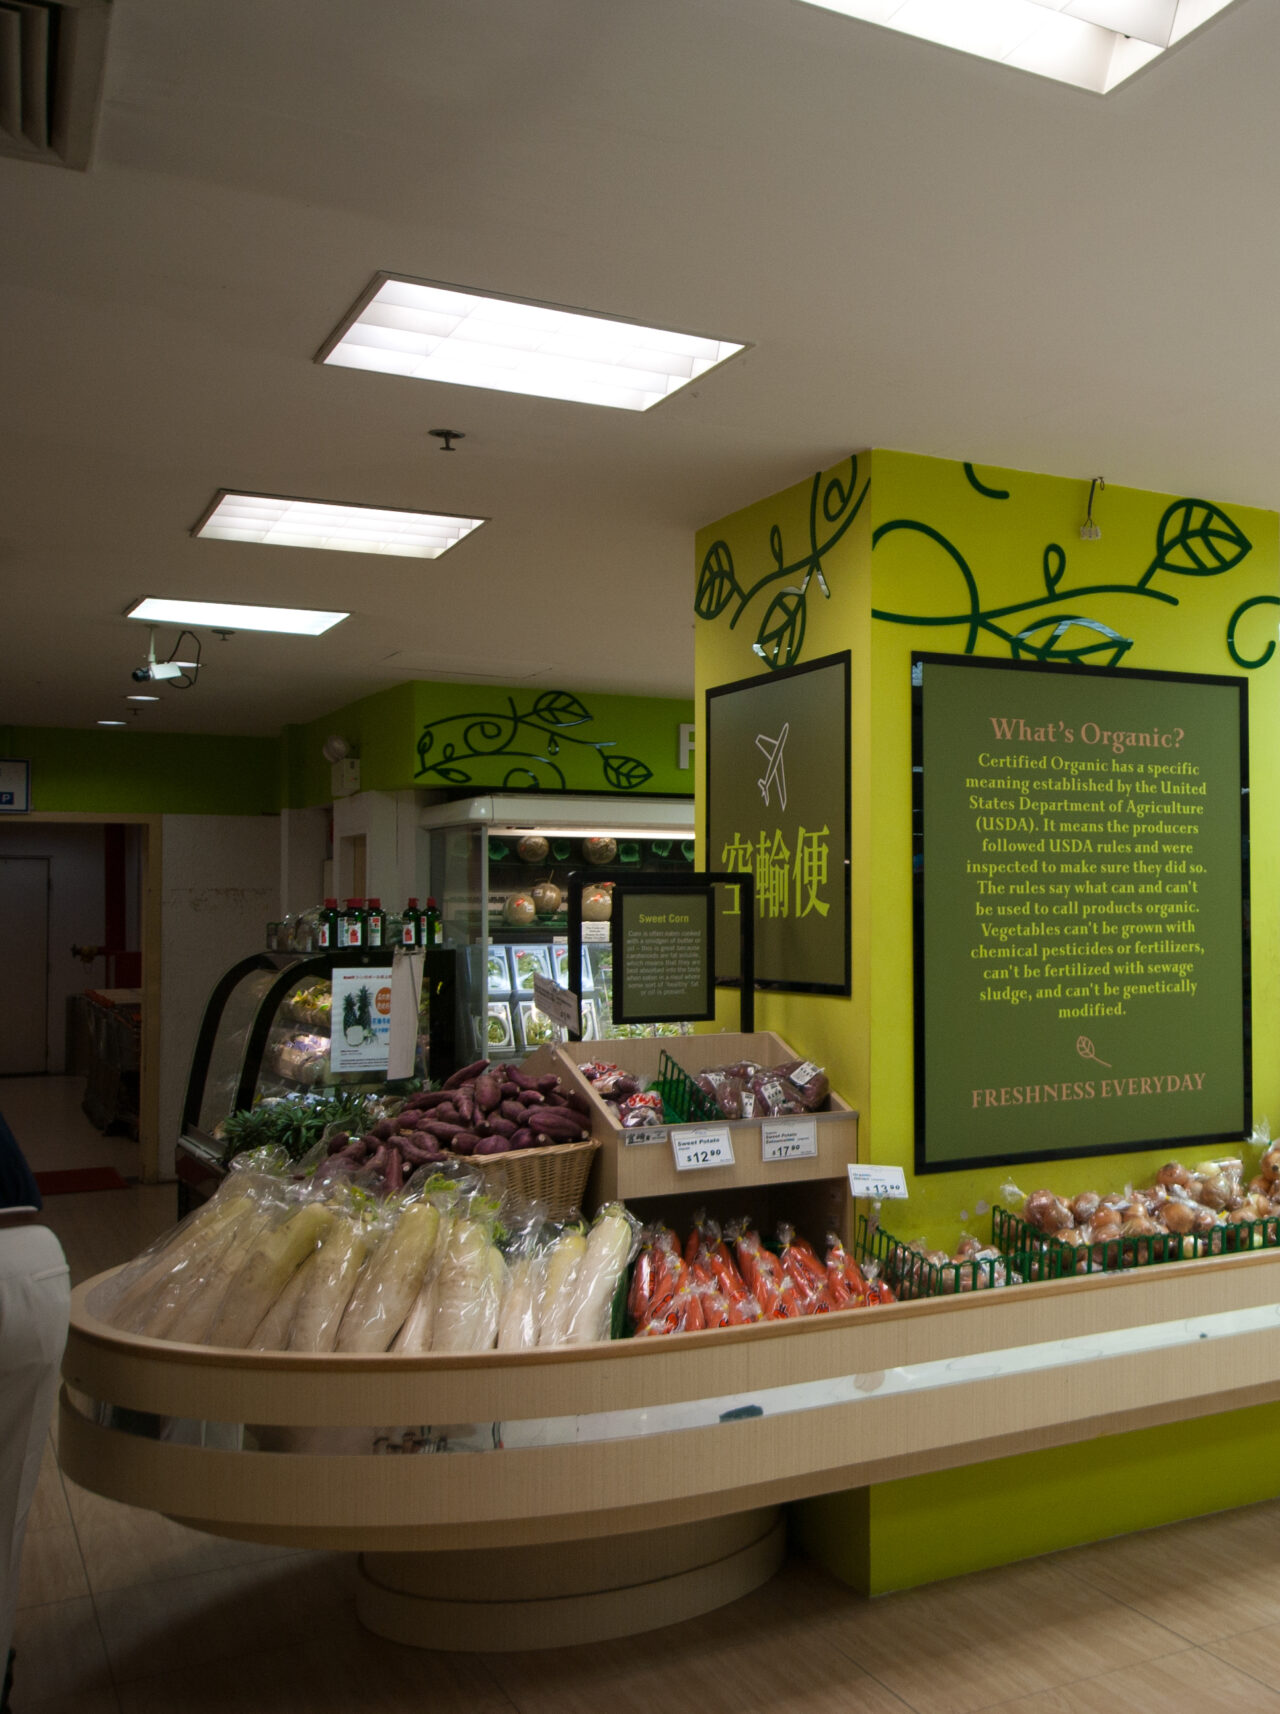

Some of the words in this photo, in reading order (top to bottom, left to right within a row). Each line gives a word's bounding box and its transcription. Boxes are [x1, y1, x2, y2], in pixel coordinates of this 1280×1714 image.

[990, 717, 1074, 743] What's
[1081, 722, 1184, 754] Organic?
[978, 753, 1046, 769] Certified
[1051, 756, 1108, 775] Organic
[1112, 759, 1134, 772] has
[1137, 764, 1144, 773] a
[1148, 762, 1199, 778] specific
[966, 776, 1030, 794] meaning
[1033, 778, 1113, 792] established
[1118, 780, 1132, 796] by
[1136, 780, 1157, 793] the
[1161, 781, 1206, 795] United
[970, 795, 1014, 810] States
[1020, 797, 1105, 815] Department
[1109, 800, 1124, 812] of
[1126, 800, 1203, 817] Agriculture
[976, 816, 1038, 833] (USDA).
[1044, 818, 1055, 831] It
[1060, 823, 1104, 832] means
[1107, 820, 1129, 832] the
[1133, 821, 1198, 837] producers
[982, 838, 1045, 852] followed
[1050, 839, 1093, 852] USDA
[1097, 840, 1131, 853] rules
[1134, 840, 1158, 853] and
[1162, 844, 1192, 854] were
[721, 824, 830, 918] 空輸便
[967, 860, 1038, 877] inspected
[1042, 861, 1056, 873] to
[1060, 860, 1097, 873] make
[1101, 864, 1130, 873] sure
[1133, 860, 1162, 877] they
[1165, 860, 1186, 873] did
[1190, 864, 1207, 873] so.
[977, 880, 1005, 894] The
[1010, 880, 1045, 894] rules
[1049, 884, 1070, 898] say
[1074, 880, 1108, 894] what
[1112, 884, 1134, 893] can
[1138, 880, 1162, 893] and
[1166, 880, 1198, 893] can't
[639, 914, 666, 923] Sweet
[668, 914, 689, 923] Corn
[976, 902, 992, 915] be
[997, 902, 1030, 915] used
[1034, 903, 1048, 915] to
[1052, 901, 1078, 914] call
[1083, 901, 1142, 918] products
[1146, 901, 1199, 918] organic.
[981, 922, 1060, 941] Vegetables
[1064, 922, 1098, 935] can't
[1102, 921, 1118, 934] be
[1122, 924, 1162, 939] grown
[1166, 920, 1195, 932] with
[971, 944, 1038, 958] chemical
[1042, 942, 1114, 960] pesticides
[1117, 945, 1131, 954] or
[1135, 940, 1204, 954] fertilizers,
[984, 964, 1019, 979] can't
[1024, 964, 1040, 978] be
[1045, 962, 1110, 977] fertilized
[1114, 961, 1144, 974] with
[1148, 963, 1193, 976] sewage
[980, 986, 1032, 1004] sludge,
[1036, 984, 1061, 998] and
[1066, 983, 1100, 997] can't
[1104, 982, 1120, 995] be
[1123, 979, 1197, 999] genetically
[1059, 1002, 1126, 1018] modified.
[972, 1081, 1095, 1108] FRESHNESS
[1101, 1073, 1206, 1098] EVERYDAY
